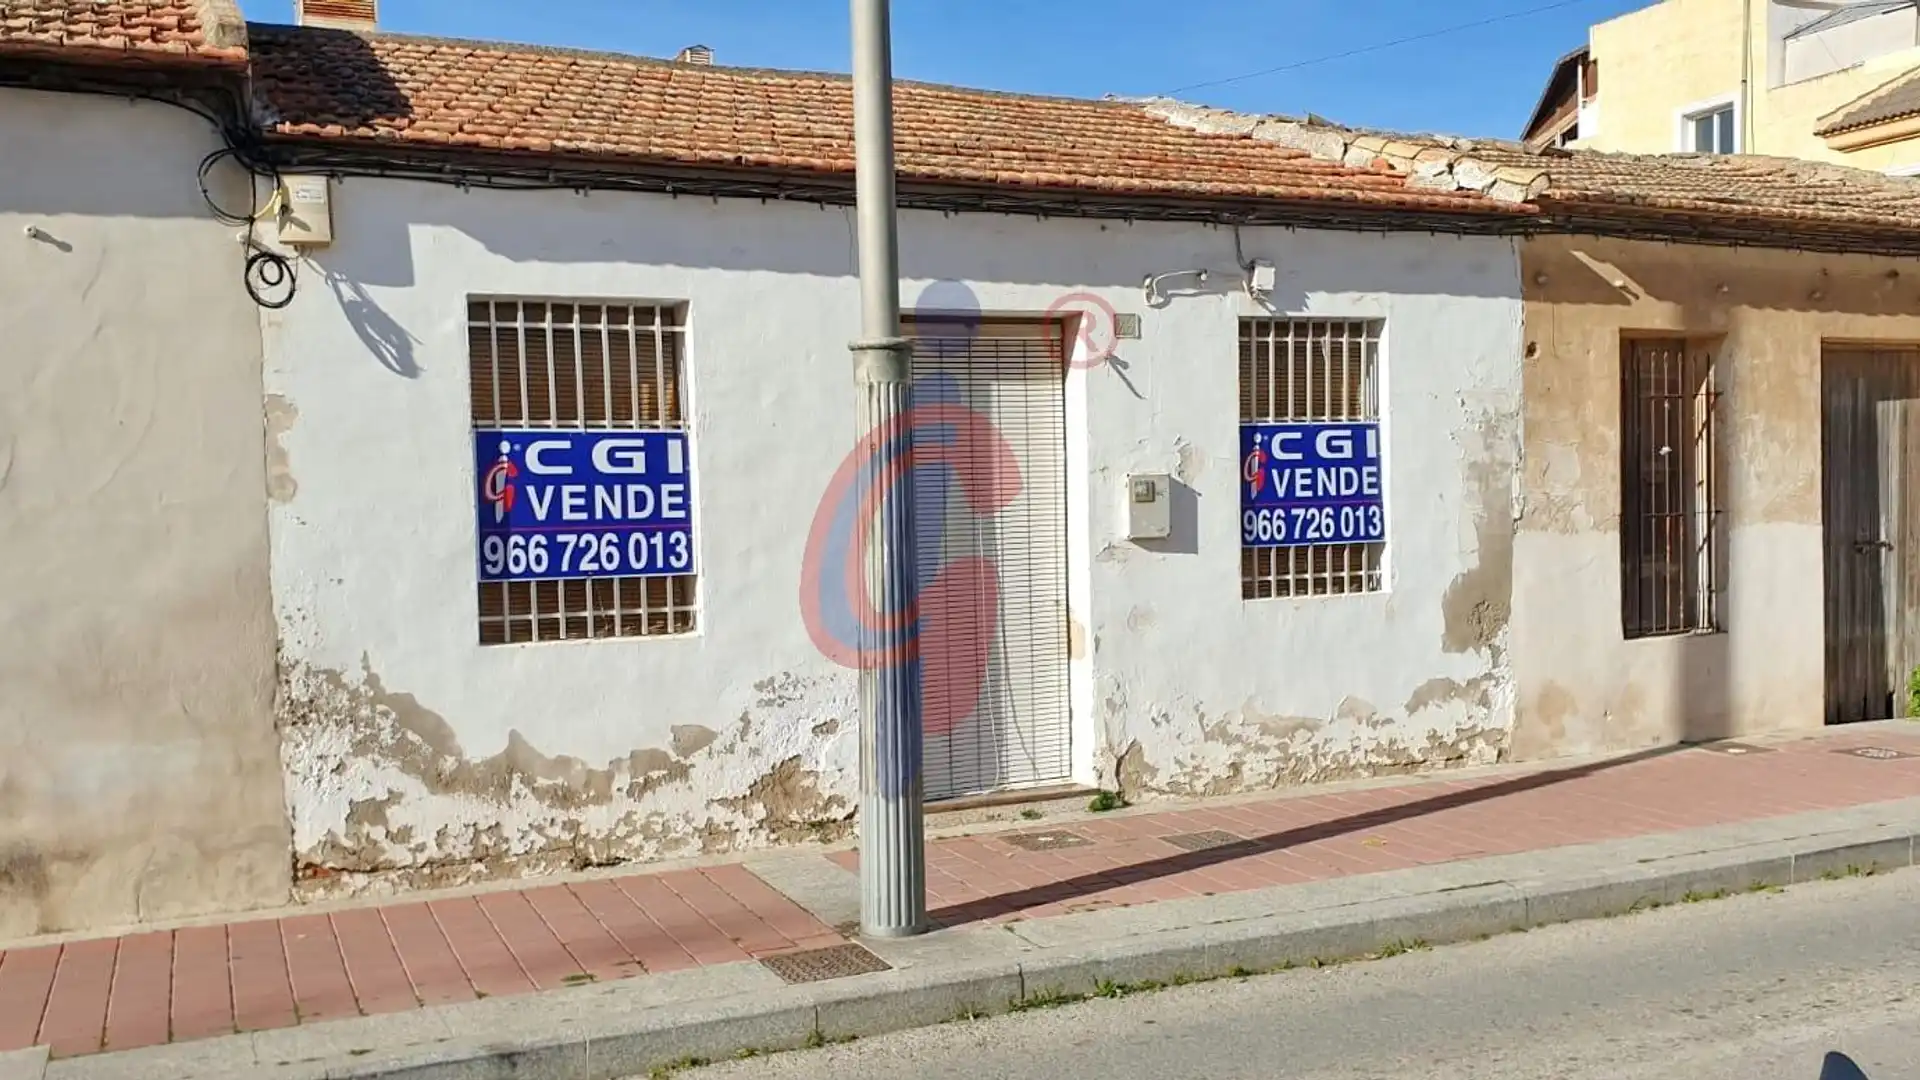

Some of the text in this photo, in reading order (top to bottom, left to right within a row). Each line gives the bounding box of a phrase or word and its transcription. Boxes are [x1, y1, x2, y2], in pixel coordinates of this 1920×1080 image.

[1271, 466, 1379, 498] VENDE
[526, 483, 686, 521] VENDE
[1243, 505, 1382, 542] 966 726 013
[483, 530, 689, 574] 966 726 013
